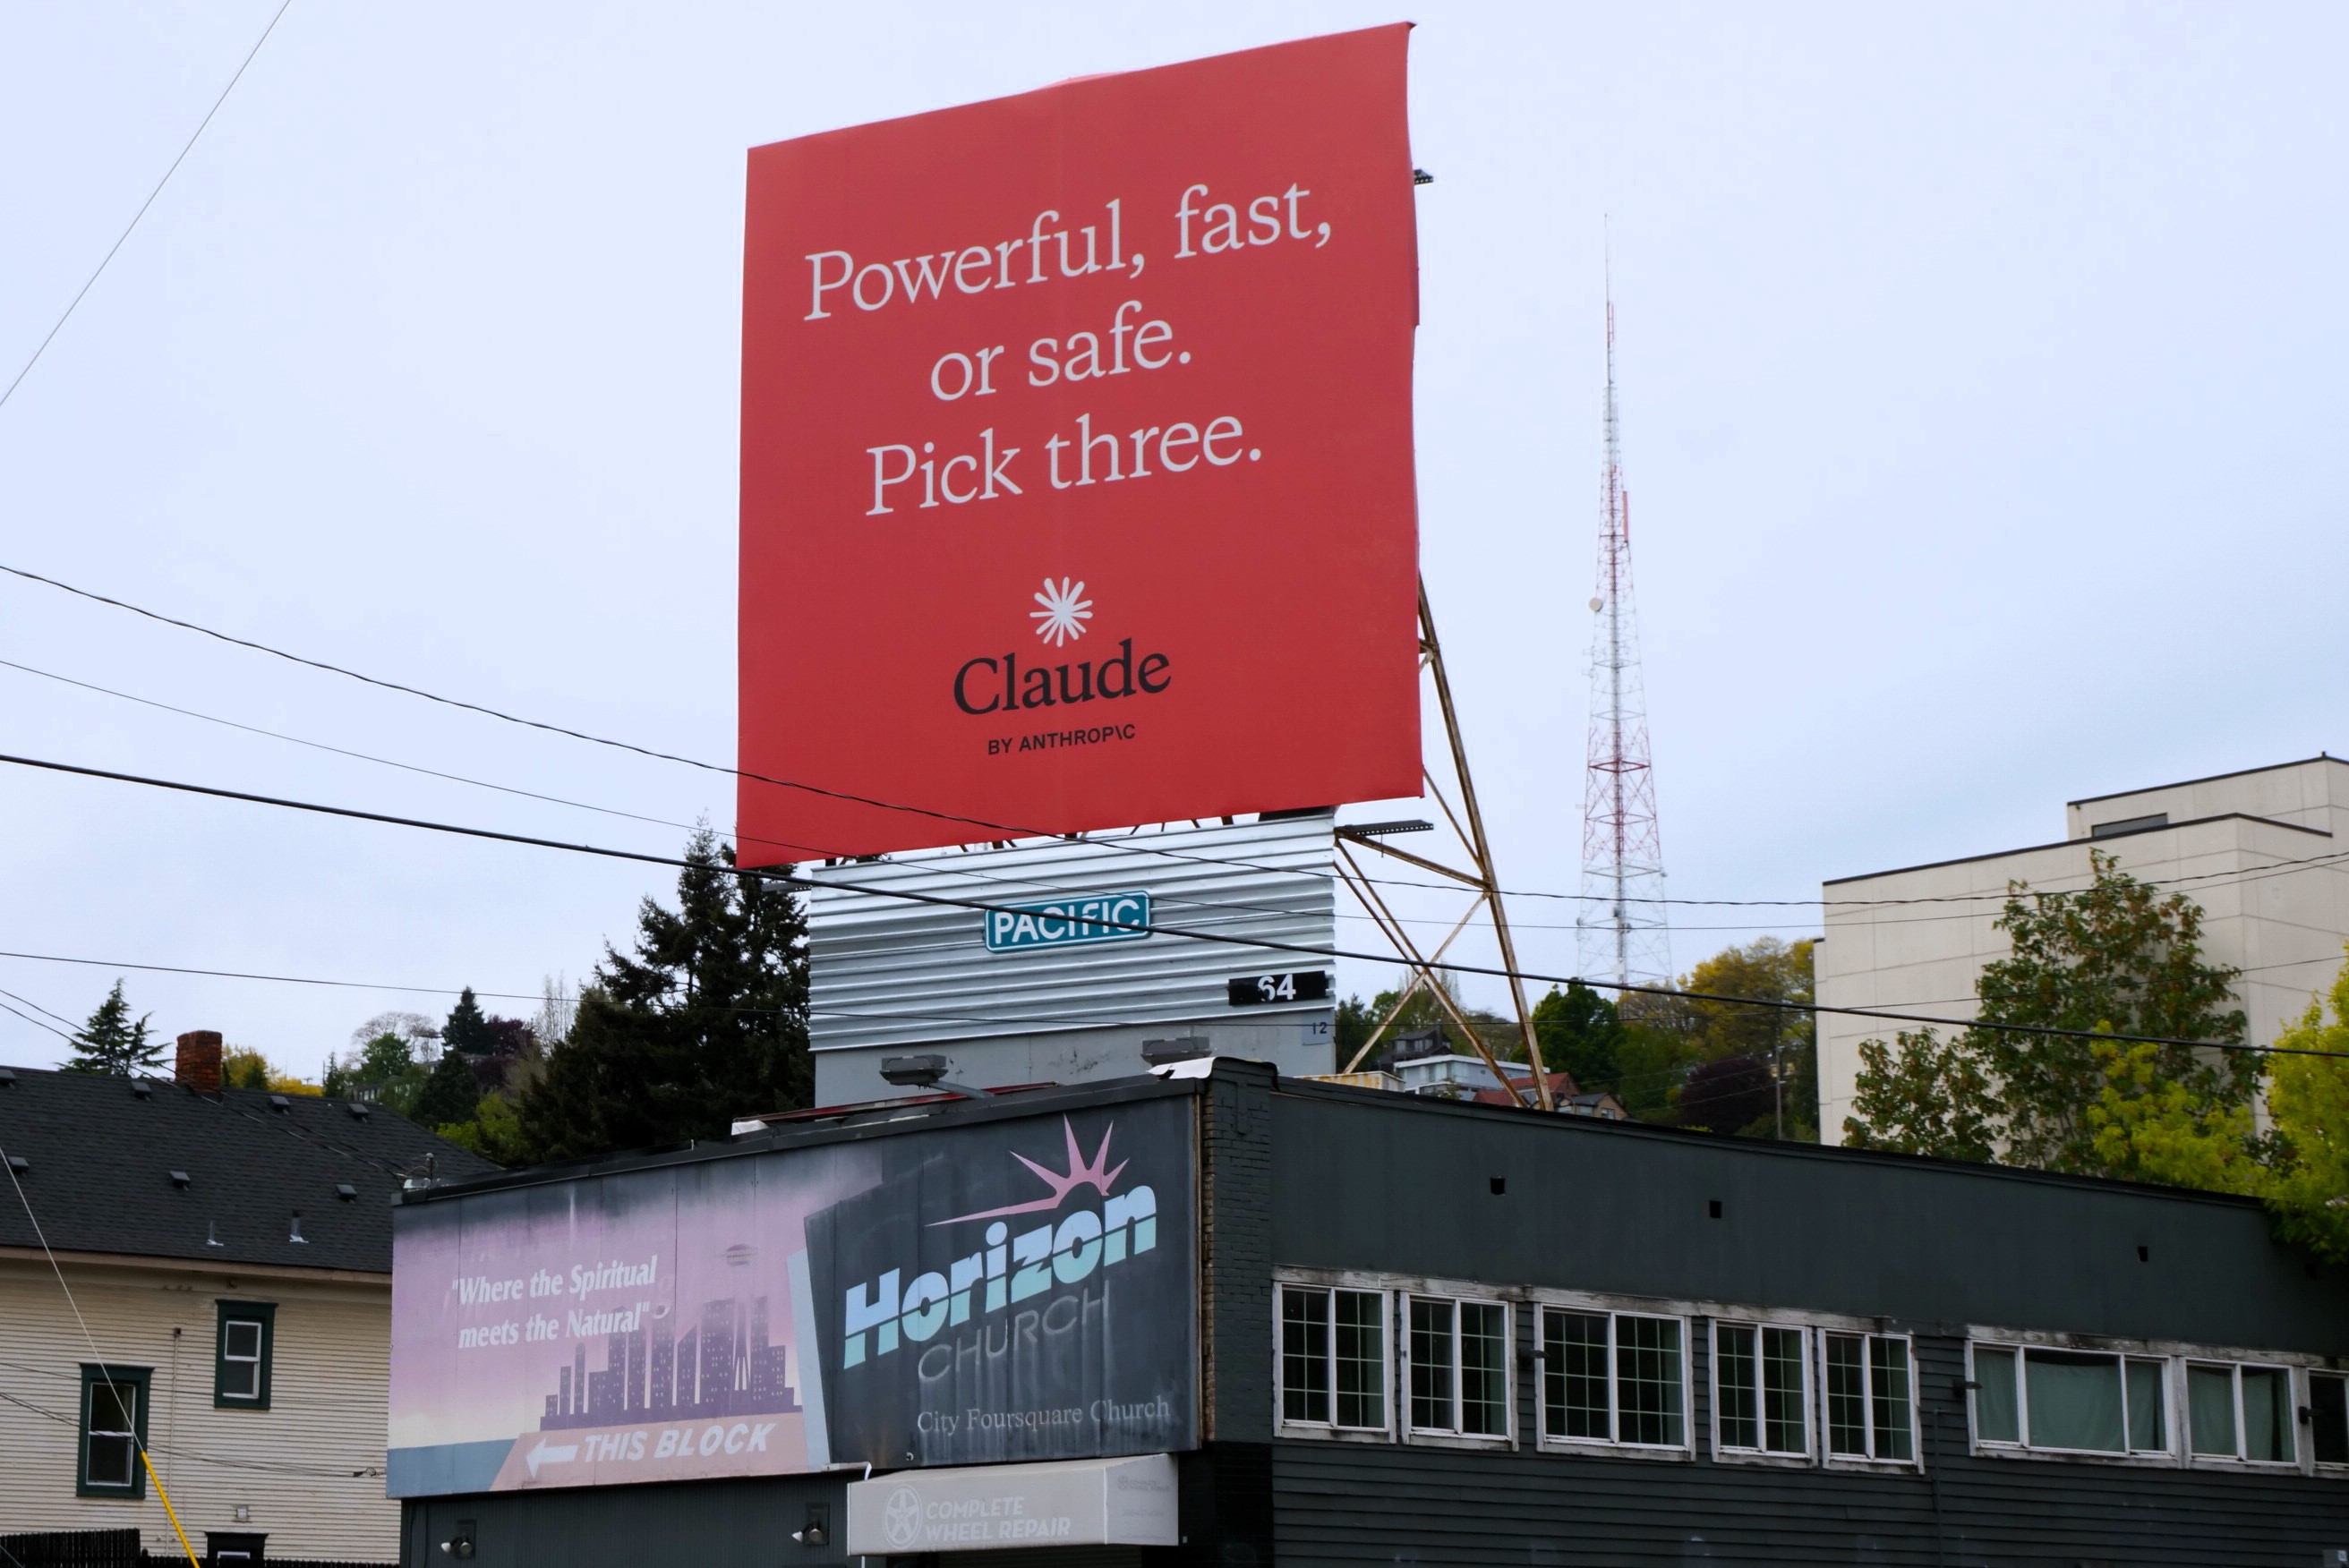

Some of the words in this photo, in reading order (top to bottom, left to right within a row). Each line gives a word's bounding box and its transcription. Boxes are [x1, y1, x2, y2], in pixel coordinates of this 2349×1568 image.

[804, 198, 1145, 321] Powerful,
[1174, 183, 1332, 259] fast,
[929, 345, 1004, 401] or
[1028, 300, 1192, 388] safe.
[866, 427, 1023, 516] Pick
[1045, 413, 1262, 490] three.
[953, 637, 1172, 715] Claude
[987, 737, 1012, 755] BY
[994, 899, 1140, 945] PACIFIC
[1312, 1022, 1327, 1035] 12
[452, 1275, 524, 1305] "Where
[529, 1268, 564, 1298] the
[570, 1255, 658, 1300] Spiritual
[843, 1185, 1157, 1370] Horizon
[458, 1317, 519, 1349] meets
[525, 1311, 559, 1341] the
[566, 1301, 650, 1339] Natural"
[918, 1280, 1109, 1384] CHURCH
[917, 1410, 960, 1434] City
[967, 1403, 1083, 1432] Foursquare
[1090, 1394, 1171, 1423] Church
[585, 1432, 647, 1462] THIS
[654, 1423, 777, 1458] BLOCK
[925, 1521, 994, 1542] WHEEL
[998, 1517, 1072, 1539] REPAIR
[926, 1496, 1025, 1520] COMPLETE
